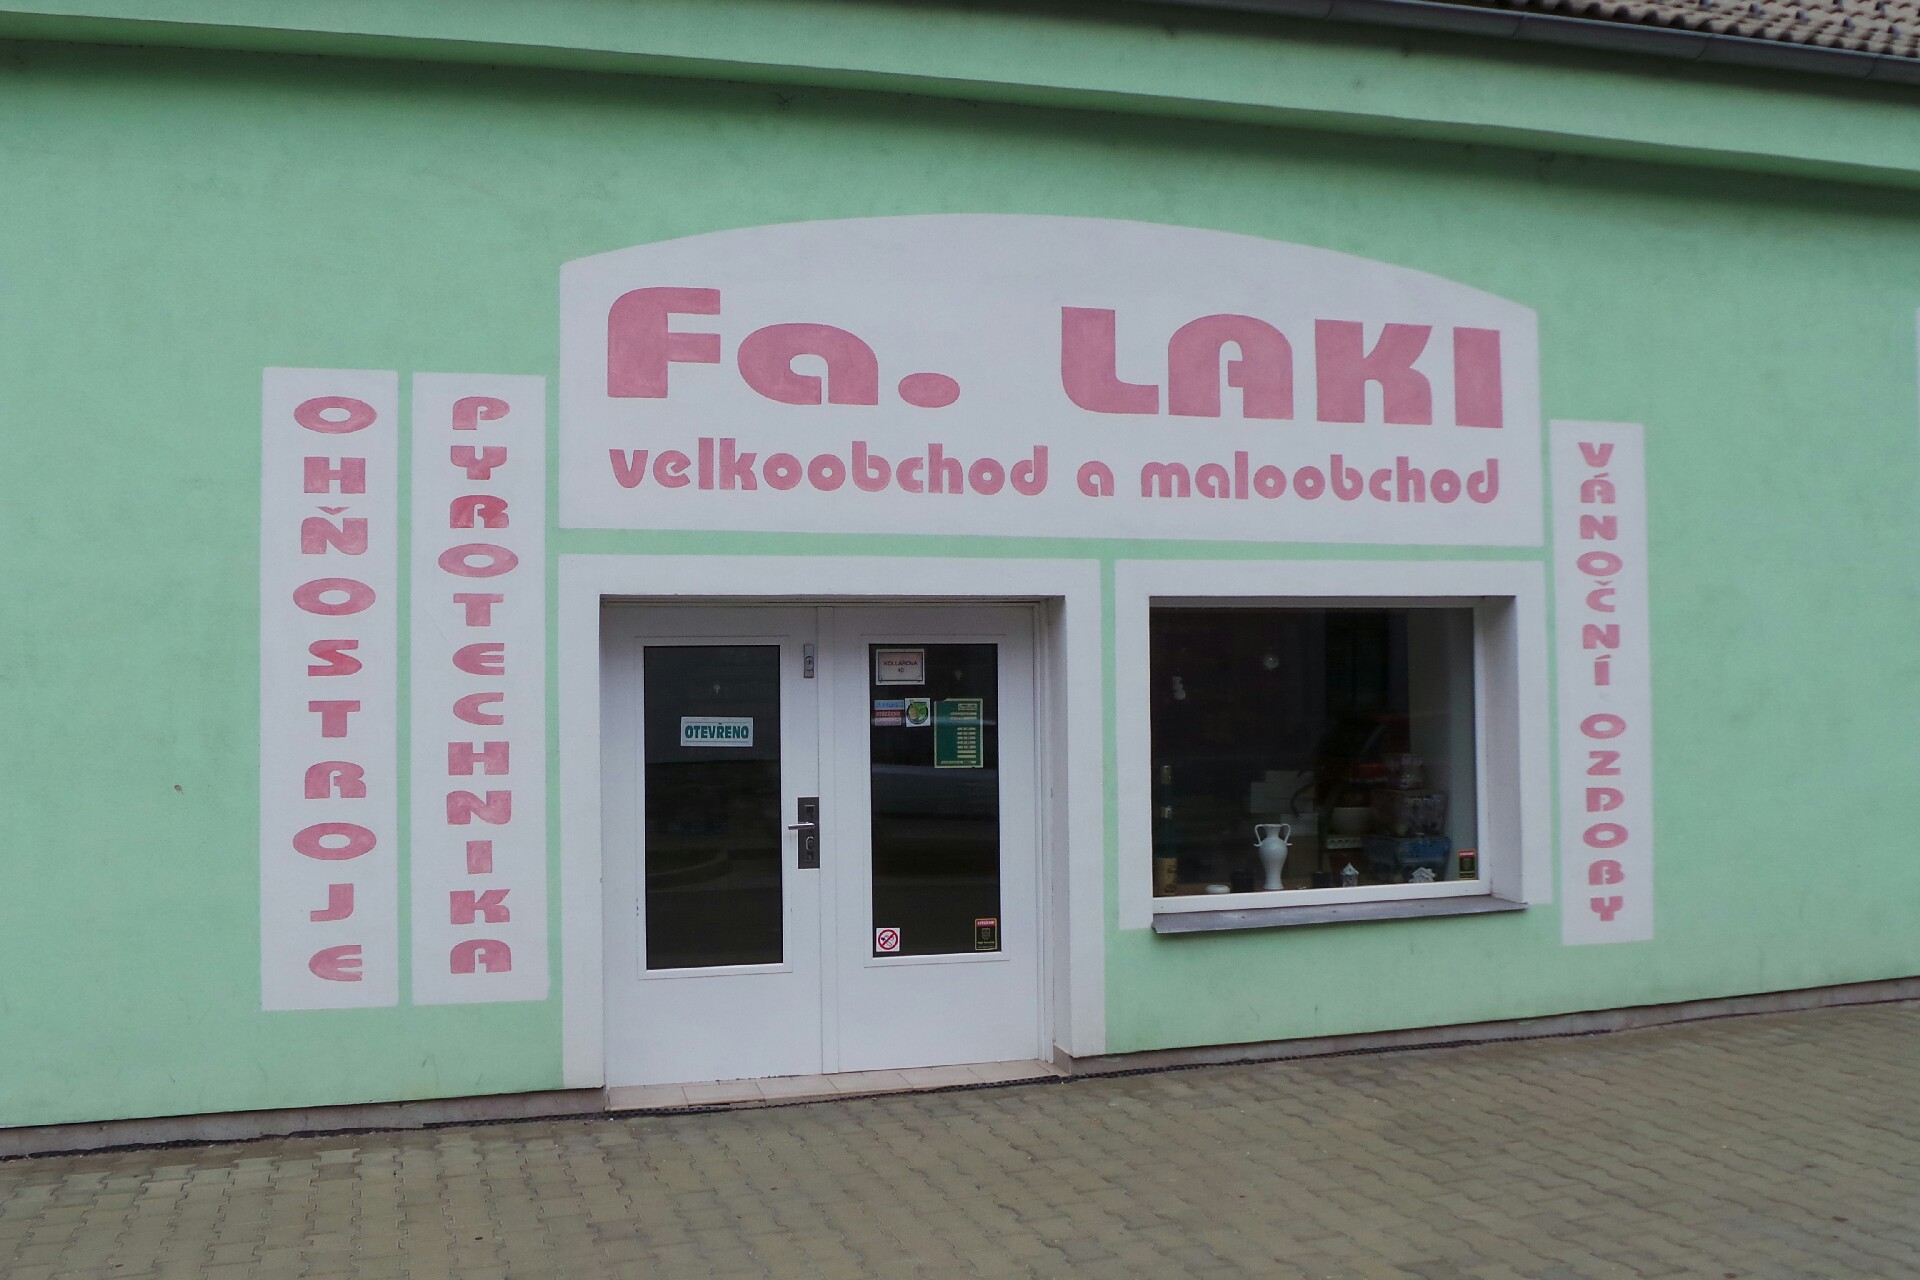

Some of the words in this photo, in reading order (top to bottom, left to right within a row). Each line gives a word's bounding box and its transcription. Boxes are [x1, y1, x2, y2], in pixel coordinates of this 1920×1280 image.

[607, 286, 960, 408] Fa.
[1061, 306, 1503, 429] LAKI
[608, 436, 1049, 496] velkoobchod
[1076, 460, 1115, 498] a
[1140, 450, 1499, 504] maloobchod
[1576, 441, 1624, 686] VÁNOČNÍ
[292, 396, 377, 982] OHŇOSTROJE
[437, 396, 519, 975] PYROTECHNIKA
[684, 722, 750, 739] OTEVŘENO
[1580, 713, 1629, 922] OZDOBY
